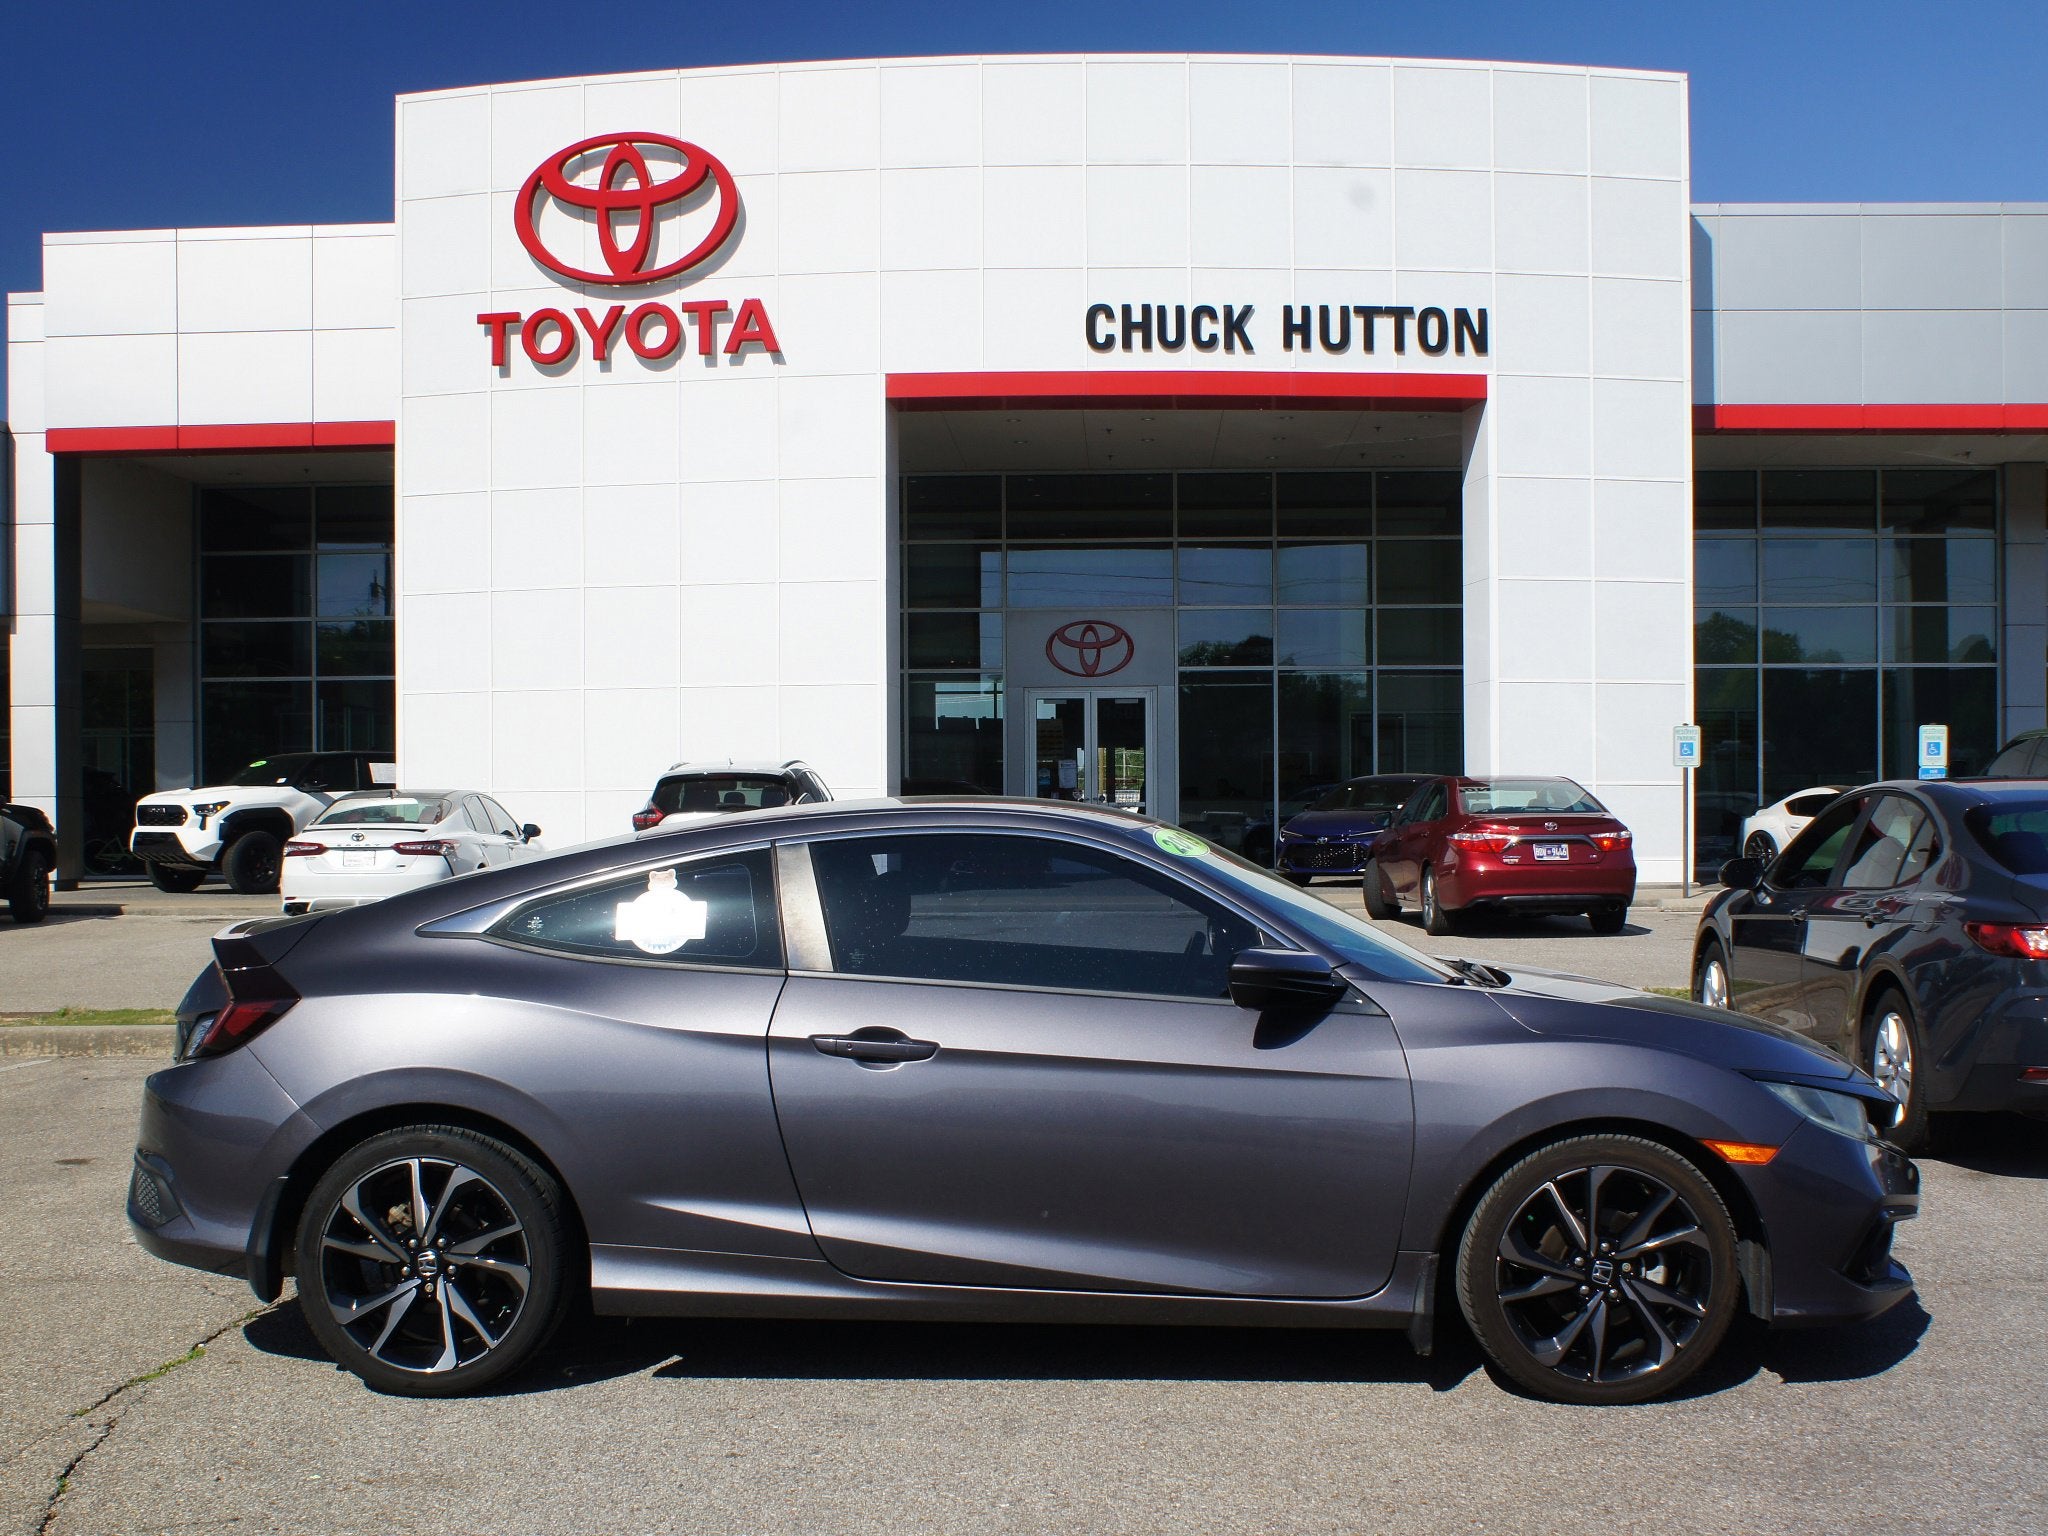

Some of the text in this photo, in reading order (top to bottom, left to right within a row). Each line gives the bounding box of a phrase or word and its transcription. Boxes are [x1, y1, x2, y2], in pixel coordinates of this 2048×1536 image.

[477, 298, 782, 367] TOYOTA
[1086, 303, 1488, 354] CHUCK HUTTON
